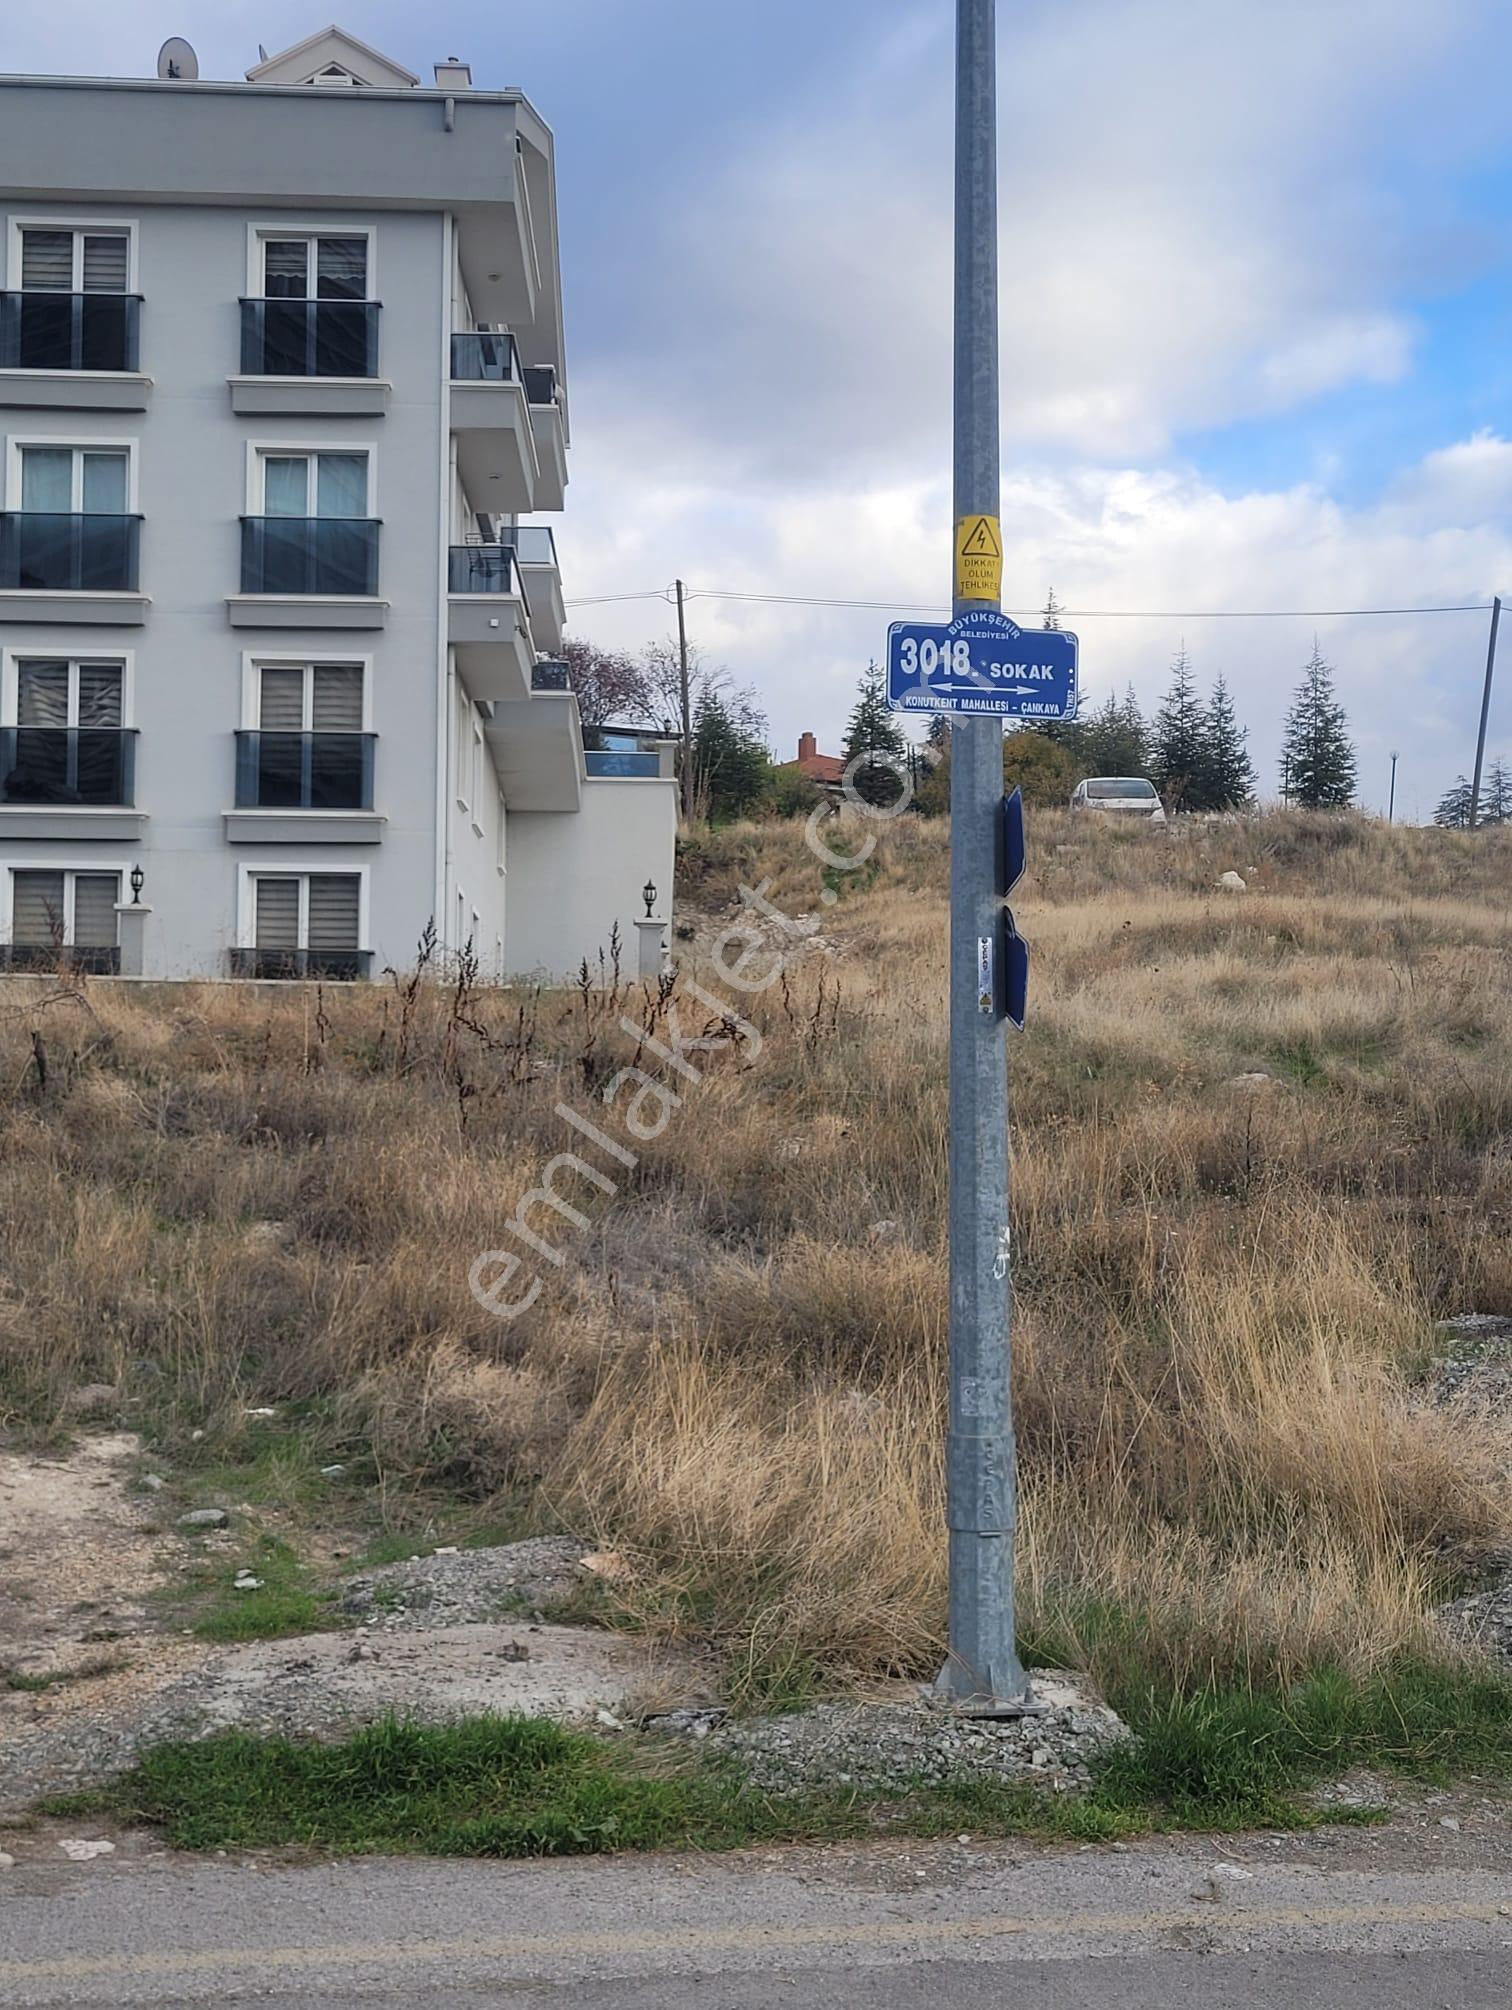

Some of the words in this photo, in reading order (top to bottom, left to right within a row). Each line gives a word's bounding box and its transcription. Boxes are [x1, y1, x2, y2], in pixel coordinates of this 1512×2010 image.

[960, 630, 1009, 640] BELEDİYESİ
[990, 663, 1054, 680] SOKAK
[905, 696, 958, 709] KONUTKENT
[961, 699, 1009, 712] MAHALLESİ
[1021, 702, 1060, 715] ÇANKAYA
